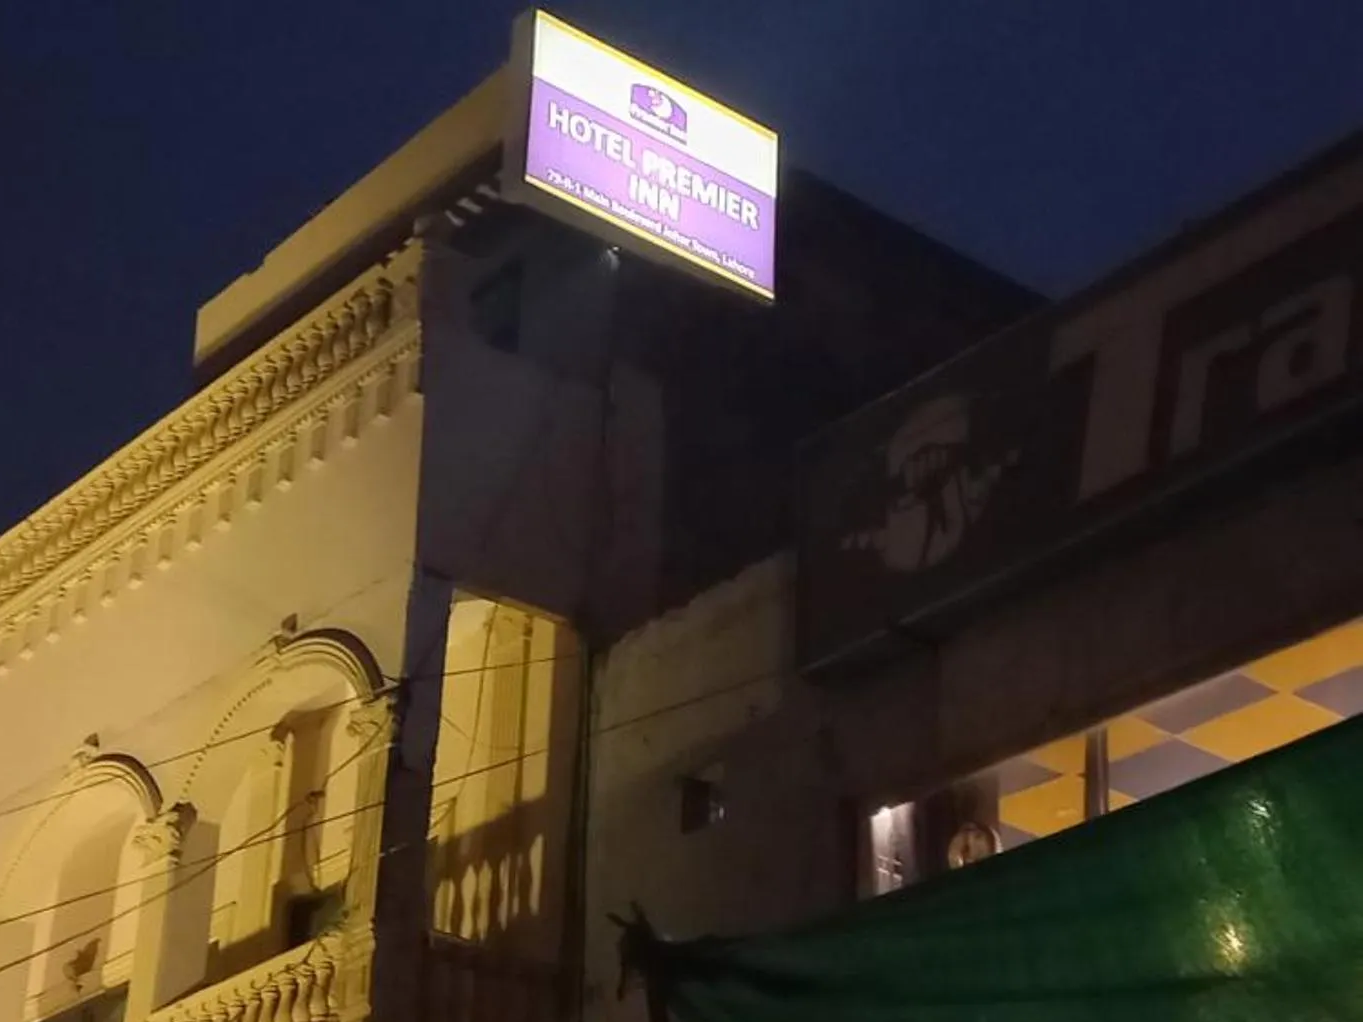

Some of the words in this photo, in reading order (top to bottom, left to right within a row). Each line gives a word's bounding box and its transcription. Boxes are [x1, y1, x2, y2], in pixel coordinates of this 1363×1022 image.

[549, 101, 634, 168] HOTEL
[642, 148, 759, 230] PREMIER
[629, 174, 681, 222] INN
